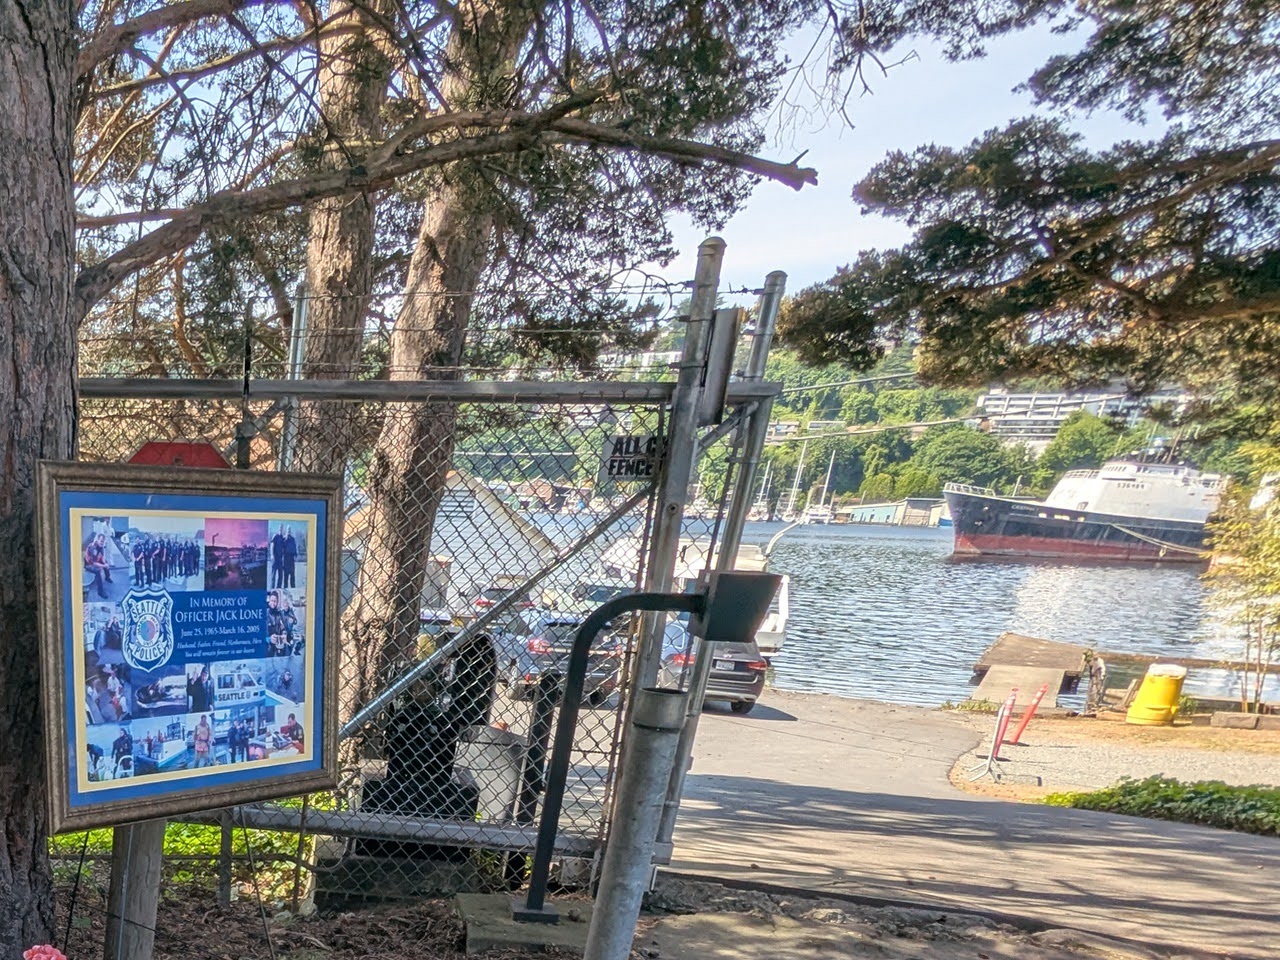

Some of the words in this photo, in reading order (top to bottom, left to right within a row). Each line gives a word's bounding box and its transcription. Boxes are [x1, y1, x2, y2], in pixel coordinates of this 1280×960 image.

[611, 436, 640, 456] ALL
[608, 459, 652, 476] FENCE
[131, 600, 165, 619] SEATTLE
[134, 645, 163, 660] POLICE
[218, 692, 245, 702] SEATTLE
